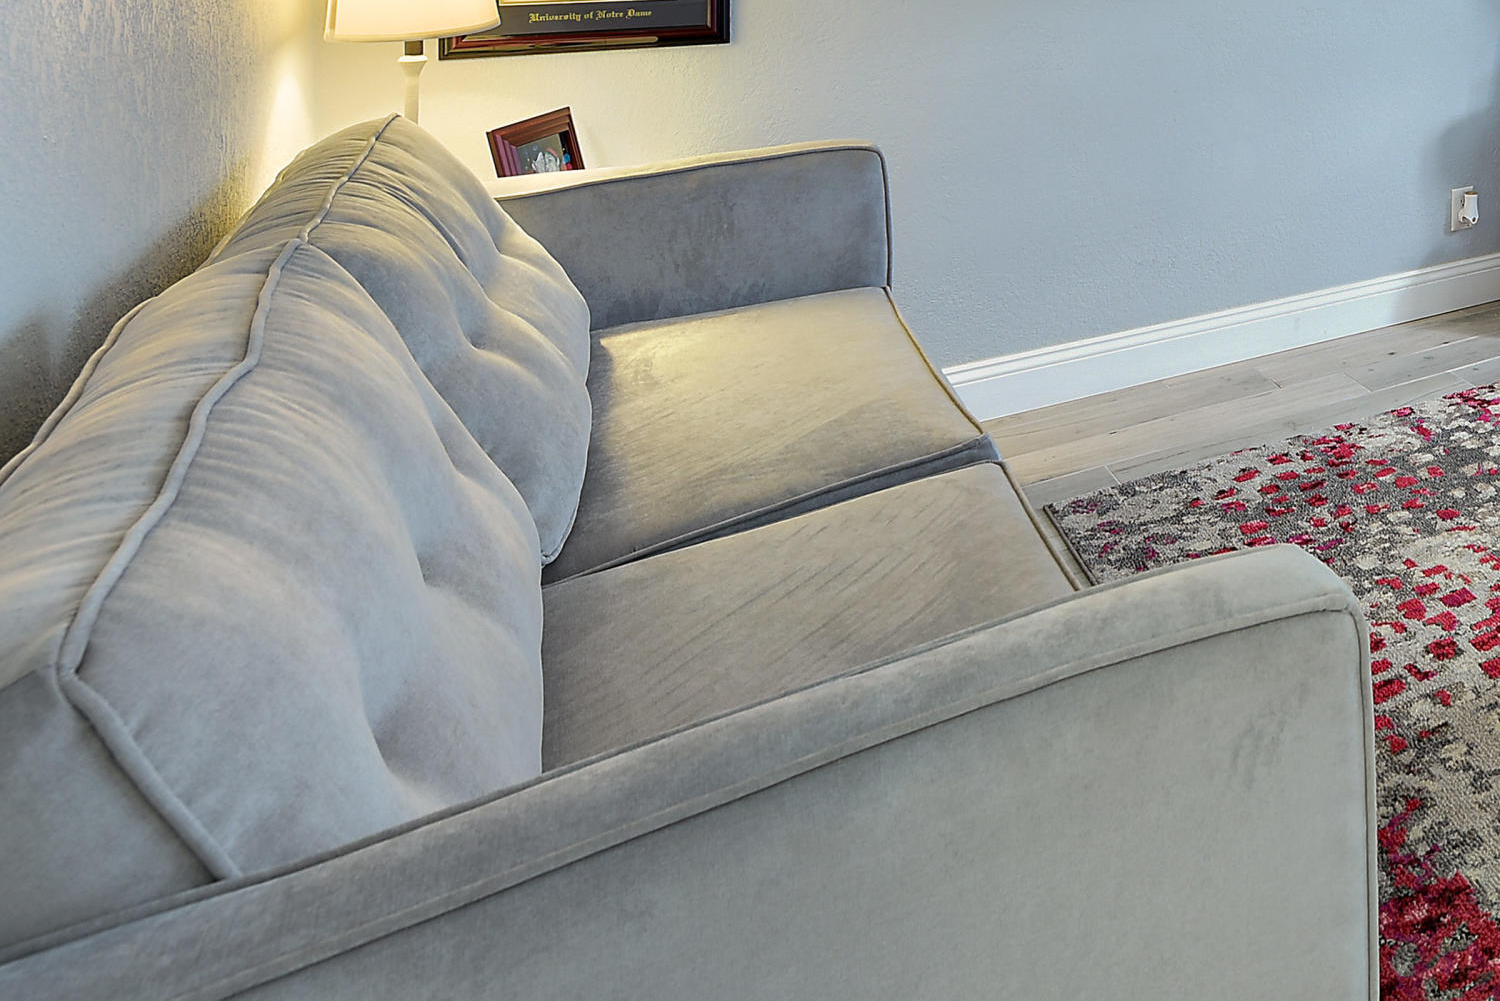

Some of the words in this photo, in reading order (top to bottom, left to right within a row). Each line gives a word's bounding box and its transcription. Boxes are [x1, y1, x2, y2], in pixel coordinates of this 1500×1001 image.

[528, 12, 581, 23] University
[584, 11, 593, 20] of
[596, 10, 623, 20] Notre
[625, 8, 652, 19] Dame
